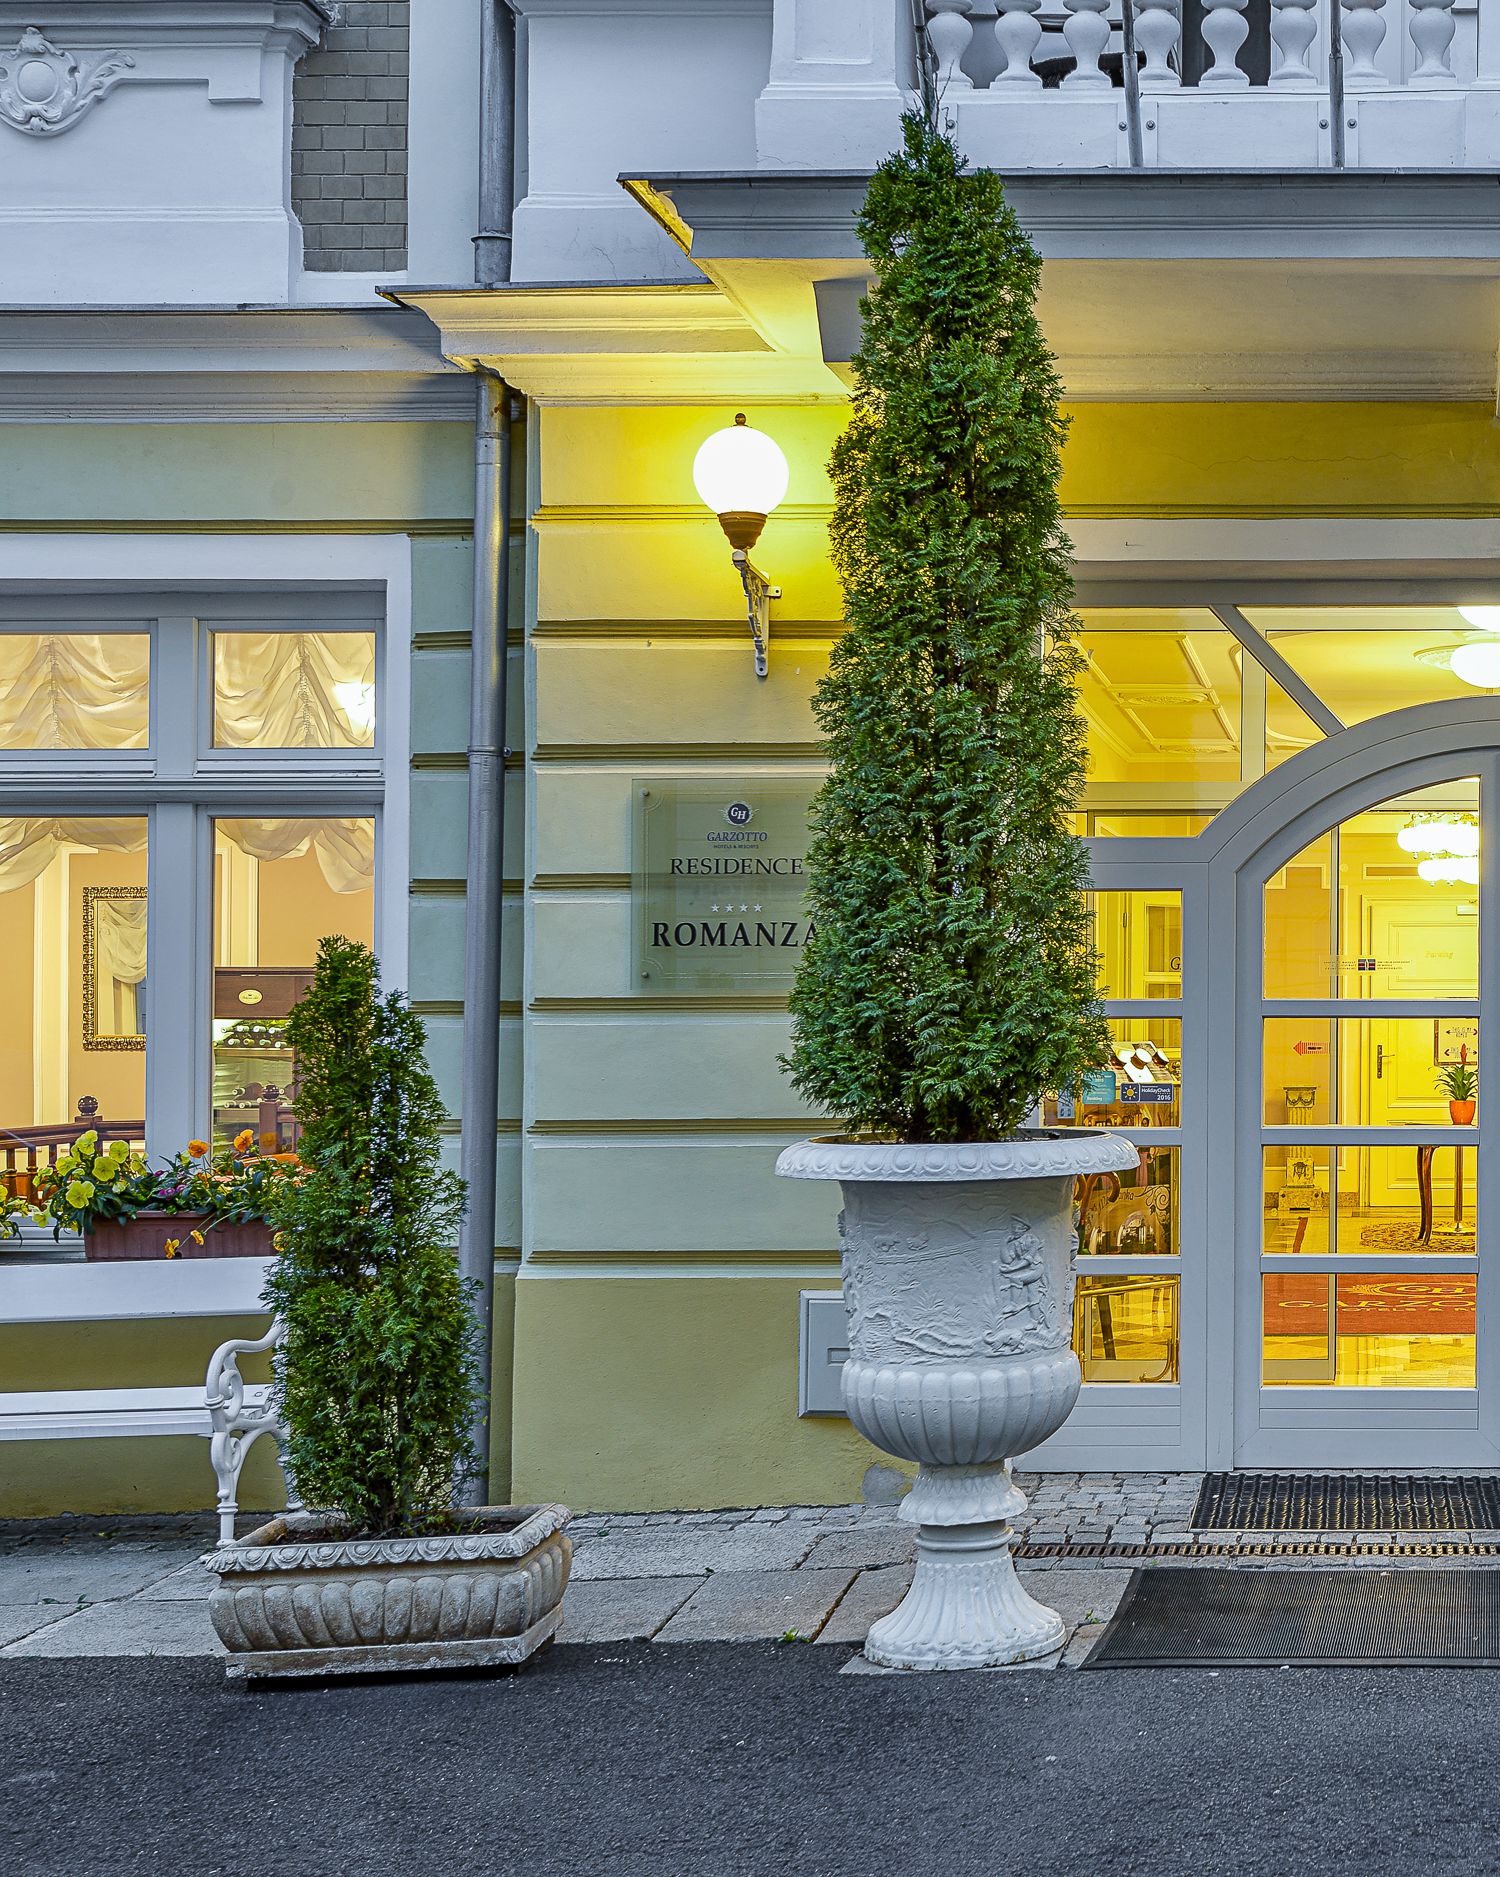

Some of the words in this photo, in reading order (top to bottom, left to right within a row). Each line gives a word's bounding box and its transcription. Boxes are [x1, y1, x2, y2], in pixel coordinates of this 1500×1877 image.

[706, 831, 768, 842] GARZOTTO
[670, 857, 804, 875] RESIDENCE
[651, 922, 816, 947] ROMANZA
